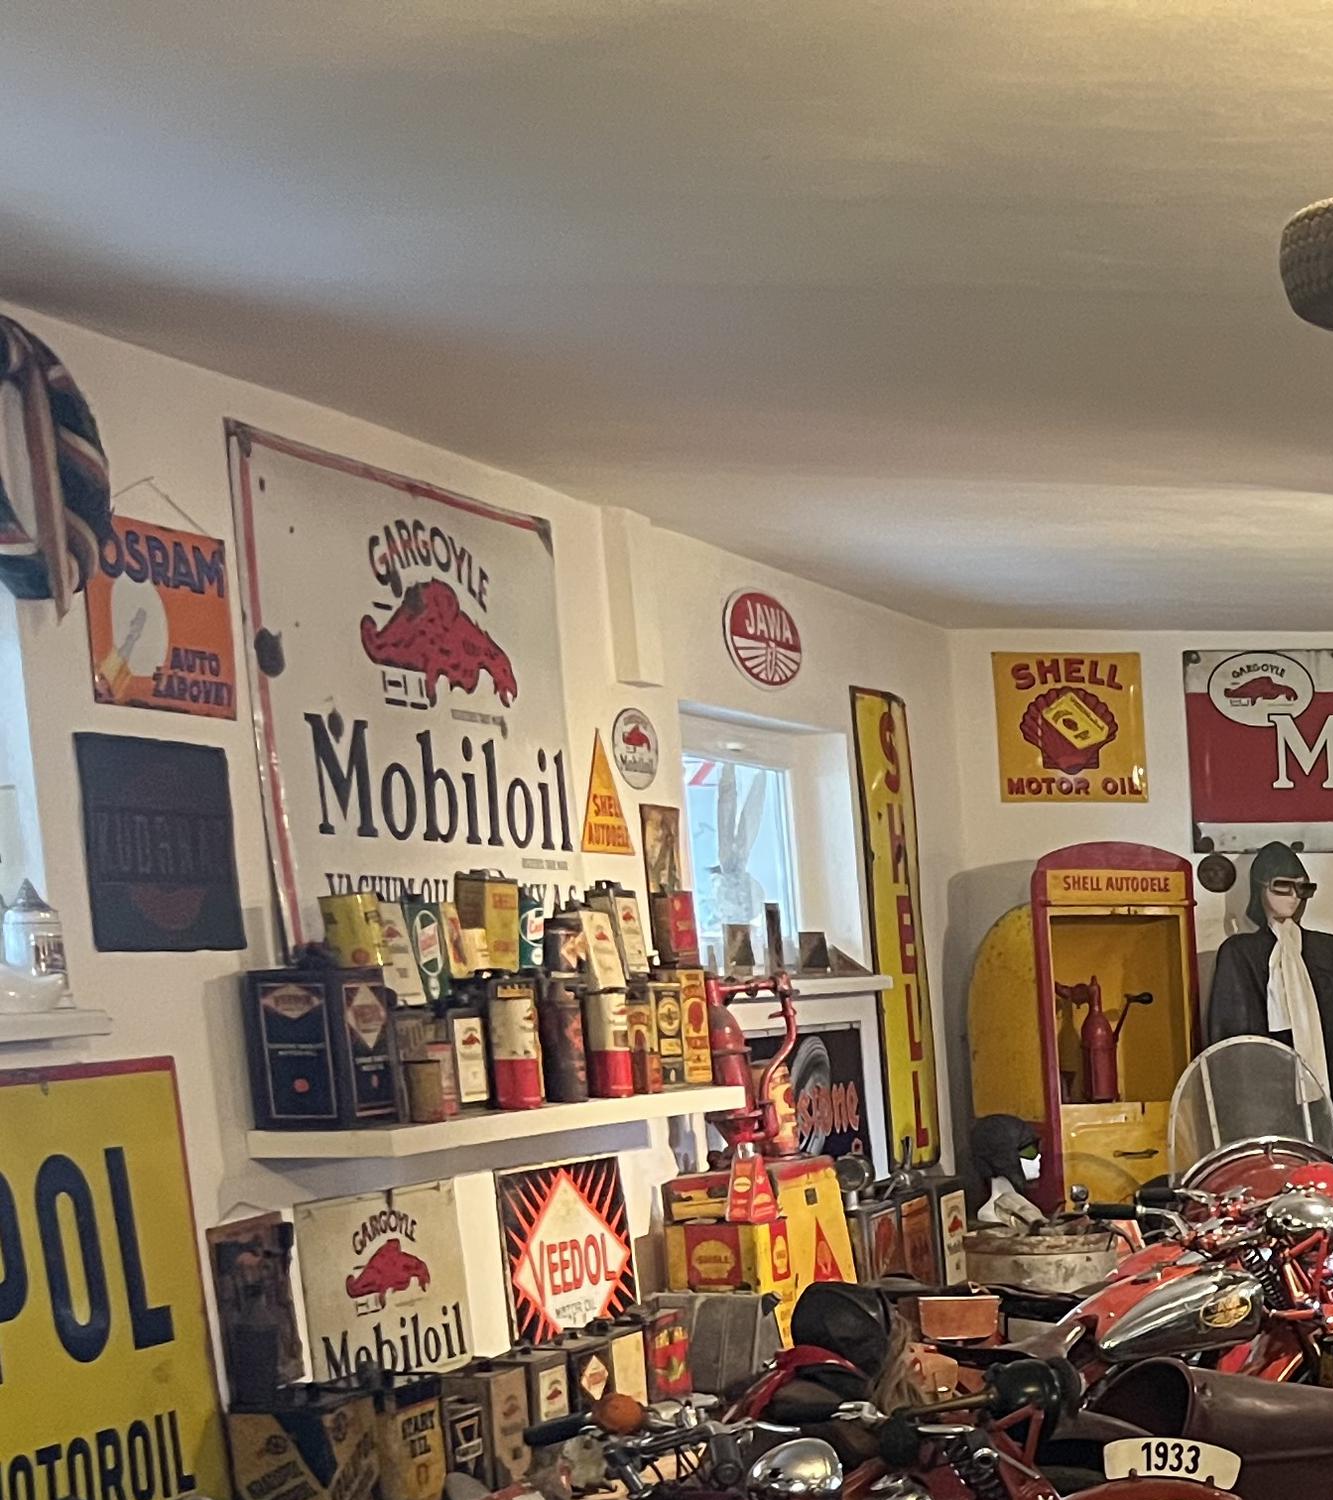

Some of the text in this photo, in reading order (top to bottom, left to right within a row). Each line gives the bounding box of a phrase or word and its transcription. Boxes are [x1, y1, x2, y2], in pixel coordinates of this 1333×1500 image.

[101, 530, 225, 599] OSRAM
[368, 518, 489, 614] GARGOYLE
[744, 599, 794, 646] JAWA
[170, 646, 220, 678] AUTO
[1010, 657, 1124, 691] SHELL
[1231, 662, 1286, 679] GARGOYLE
[304, 711, 574, 853] Mobiloil
[1007, 776, 1143, 796] MOTOR OIL
[1062, 875, 1103, 893] SHELL
[352, 1209, 418, 1255] GARGOYLE
[526, 1232, 619, 1309] VEEDOL
[321, 1300, 468, 1379] Mobiloil
[1141, 1441, 1201, 1475] 1933
